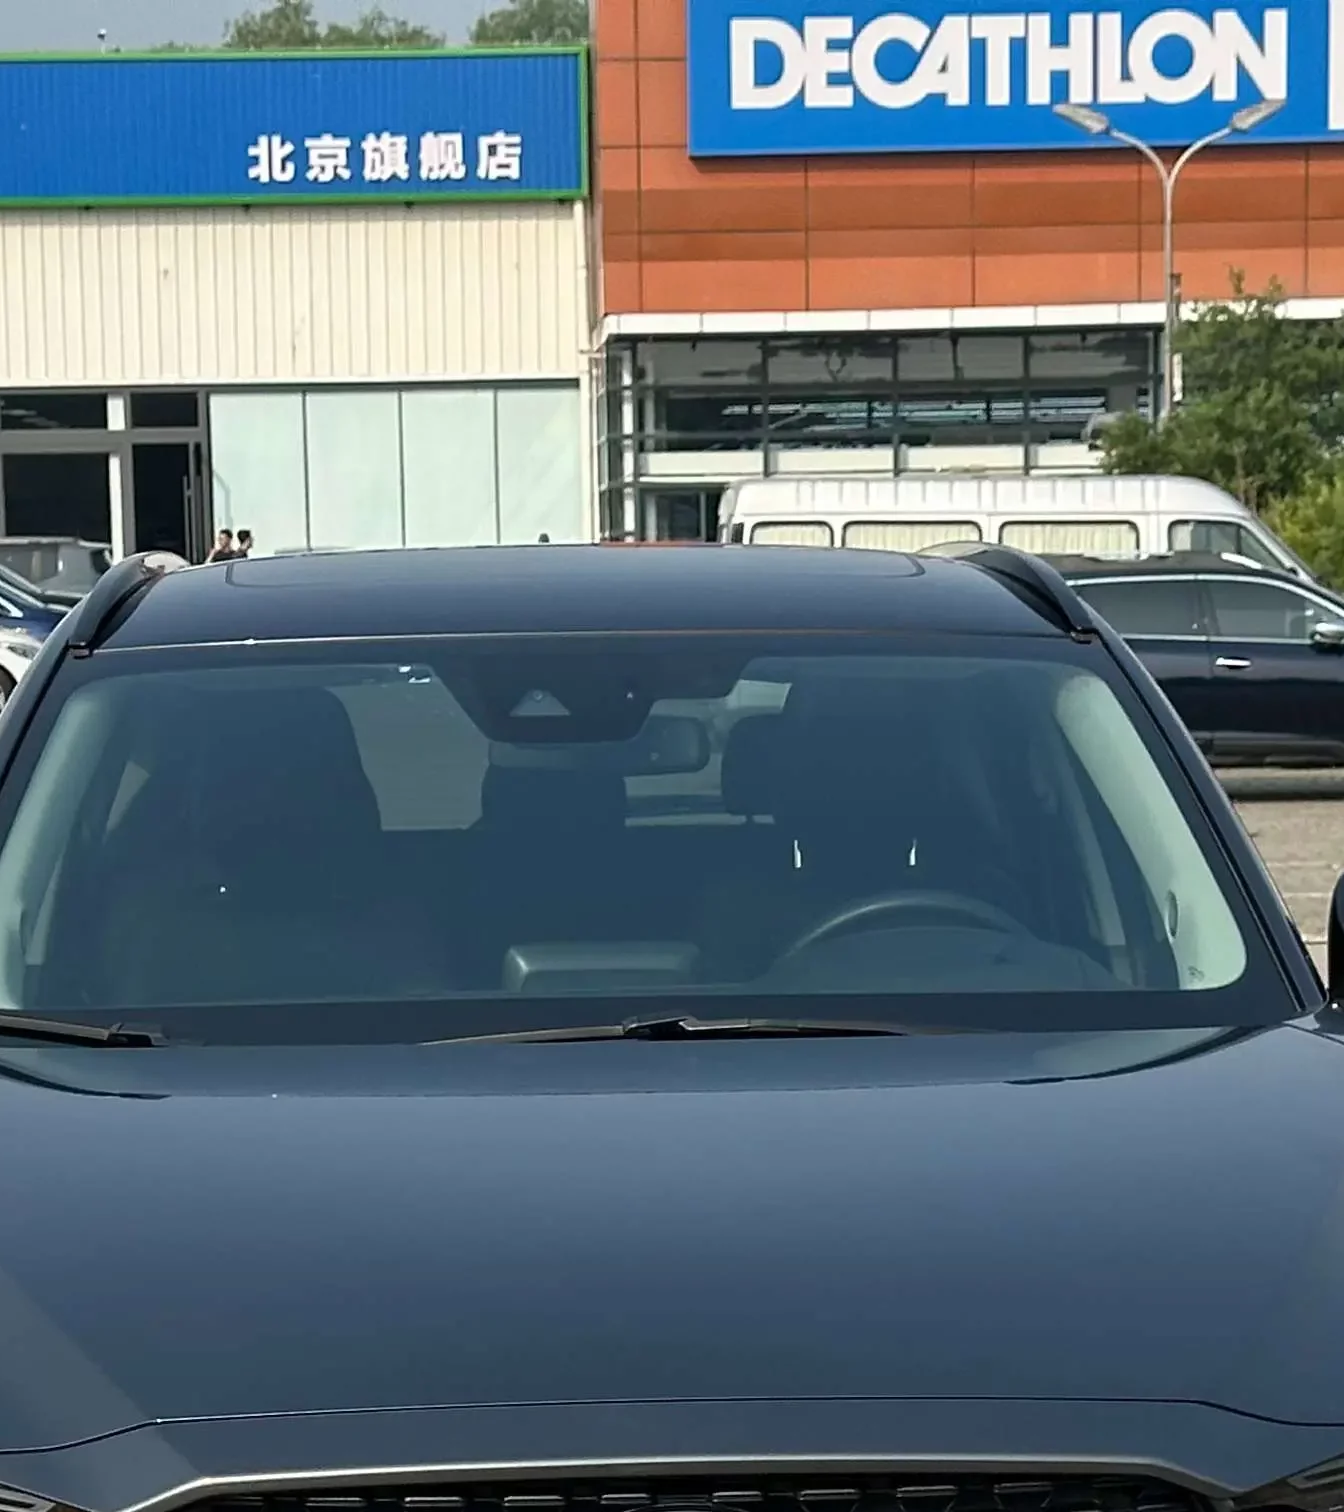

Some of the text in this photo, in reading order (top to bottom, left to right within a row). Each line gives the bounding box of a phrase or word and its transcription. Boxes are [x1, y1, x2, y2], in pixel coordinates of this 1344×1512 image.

[729, 8, 1288, 110] DECATHLON
[247, 130, 522, 183] 北京旗舰店
